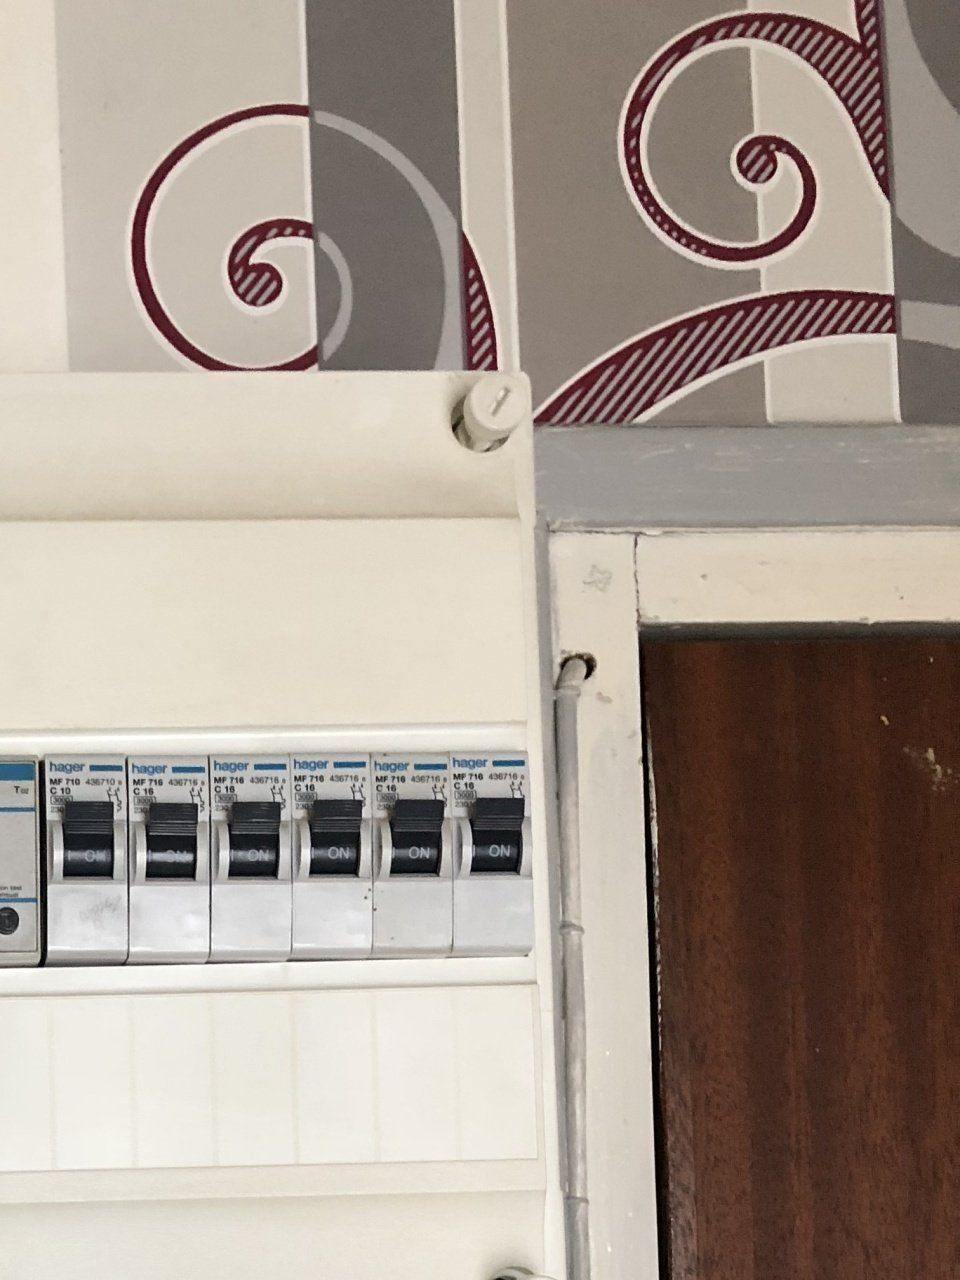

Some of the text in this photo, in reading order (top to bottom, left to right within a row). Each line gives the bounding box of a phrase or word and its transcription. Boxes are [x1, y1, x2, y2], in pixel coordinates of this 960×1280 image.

[50, 762, 85, 773] hager
[132, 763, 167, 775] hager
[214, 760, 249, 772] hager
[294, 759, 329, 771] hager
[374, 761, 409, 773] hager
[453, 757, 488, 769] hager
[66, 778, 80, 786] 710
[214, 776, 227, 784] MF
[230, 776, 244, 784] 716
[294, 775, 307, 783] MF
[310, 775, 325, 783] 716
[391, 775, 406, 783] 716
[453, 773, 467, 781] MF
[469, 773, 483, 781] 716
[295, 784, 315, 792] C 16
[454, 782, 475, 790] C 16
[248, 850, 269, 862] ON
[328, 847, 350, 859] ON
[409, 847, 430, 859] ON
[489, 845, 511, 857] ON
